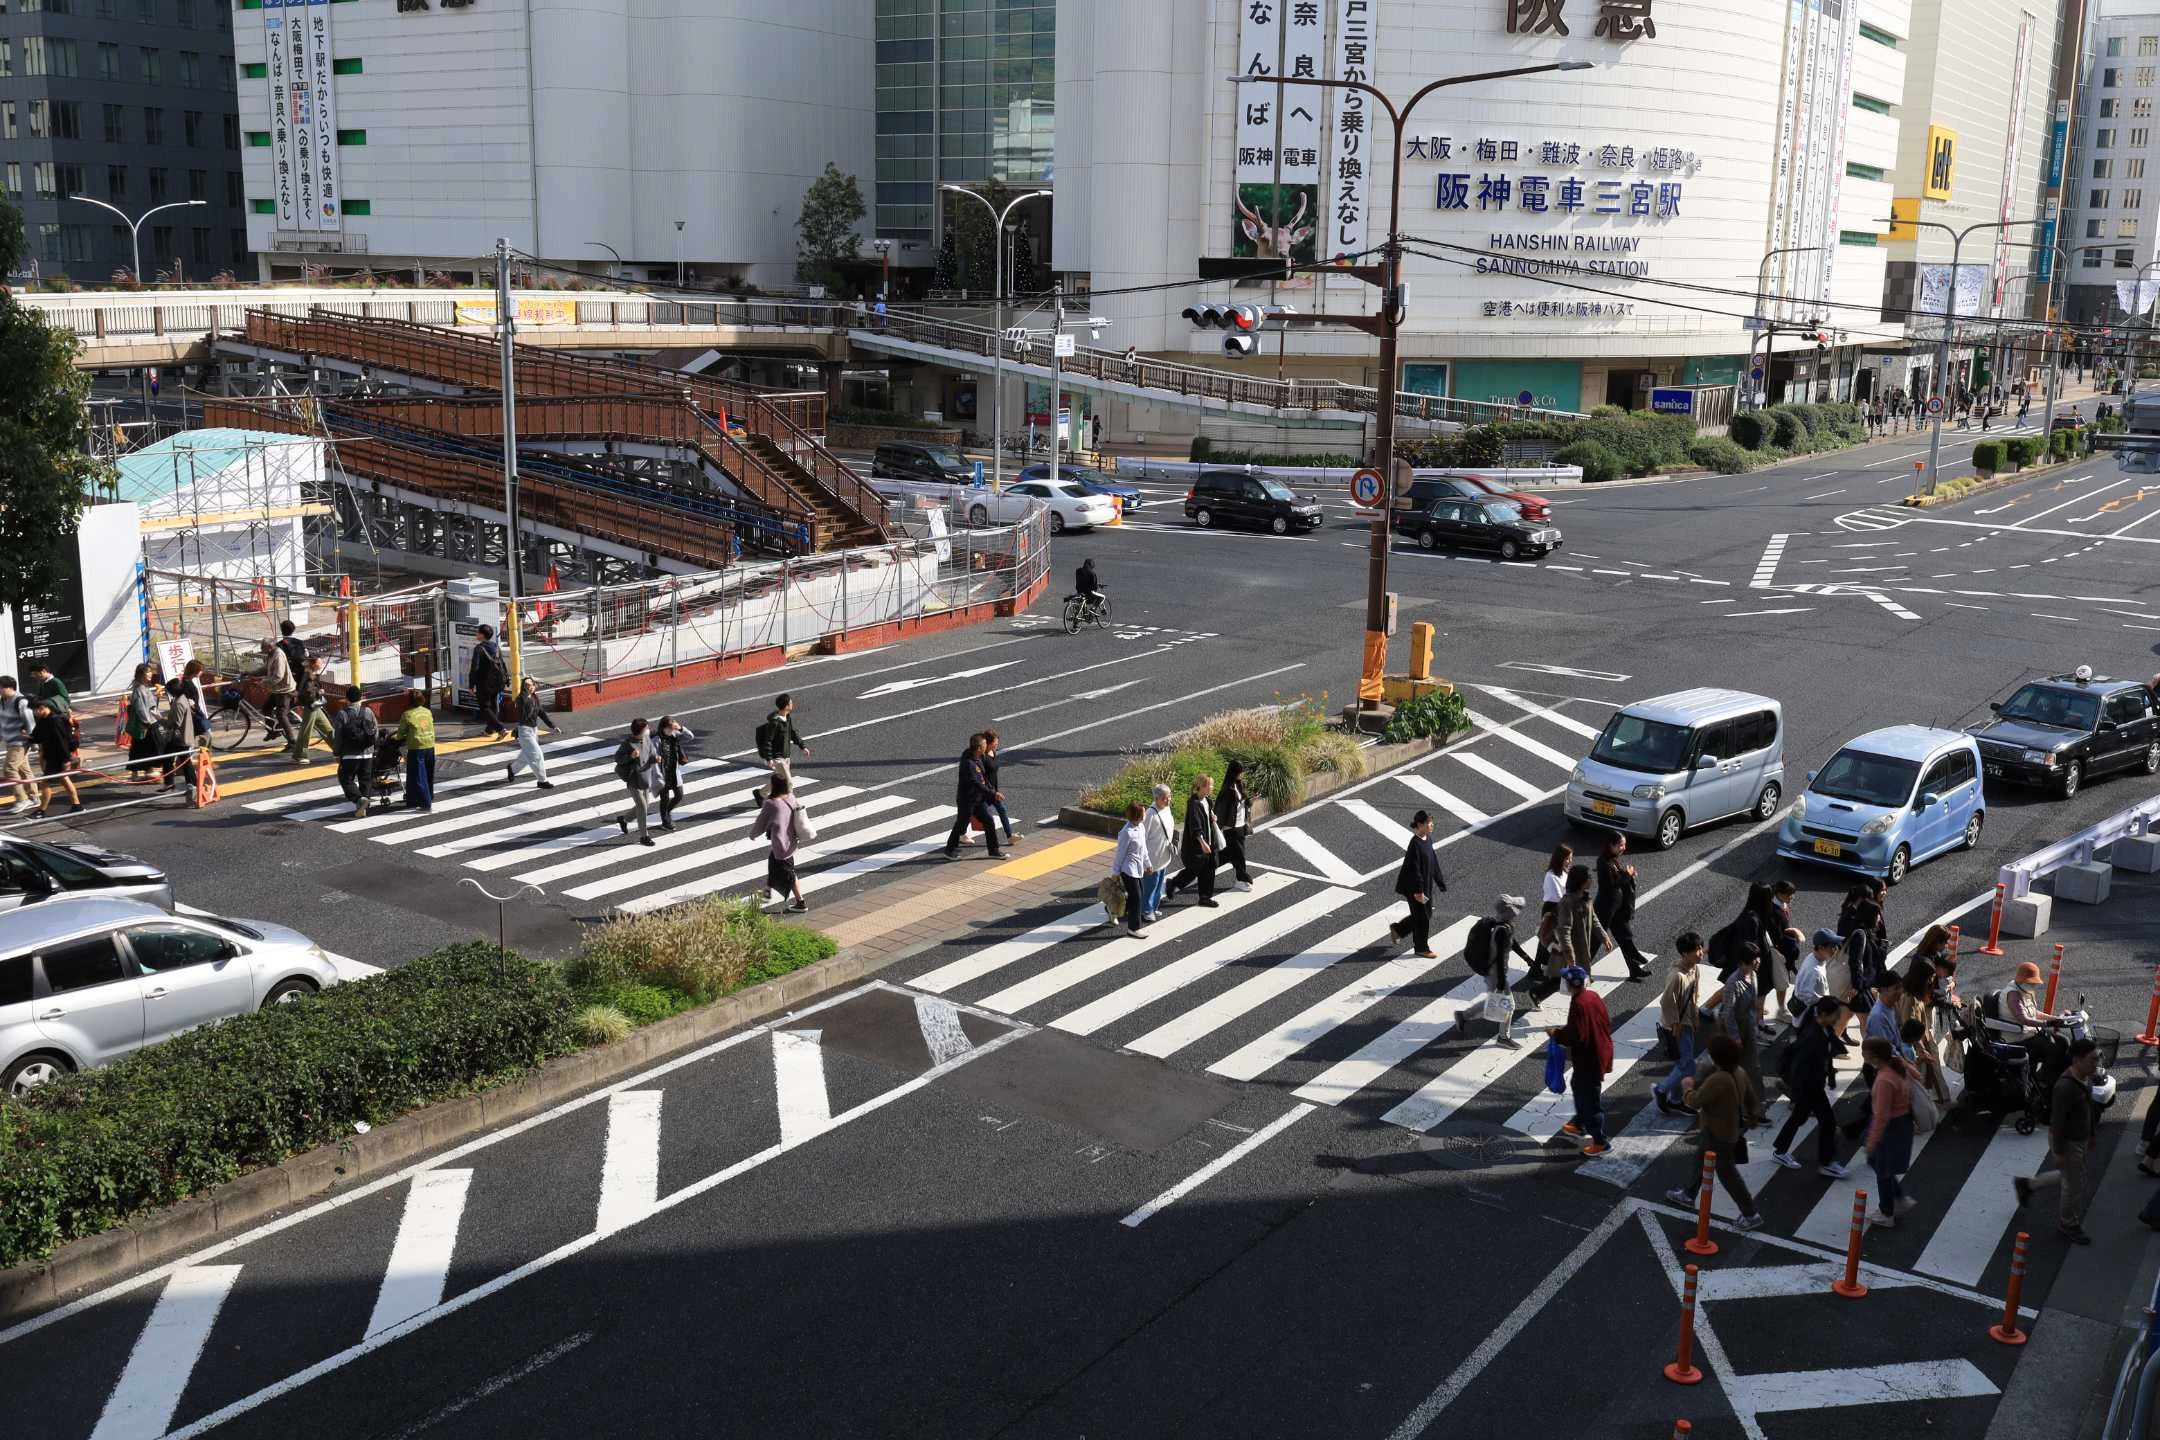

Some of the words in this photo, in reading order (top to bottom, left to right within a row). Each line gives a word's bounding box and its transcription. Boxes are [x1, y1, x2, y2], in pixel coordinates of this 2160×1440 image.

[1246, 1, 1272, 126] なんば
[1290, 2, 1318, 123] 奈良へ
[313, 16, 333, 198] 地下駅だからいつも快適
[1931, 136, 1952, 191] Loft
[1436, 173, 1682, 217] 阪神電車三宮駅
[1476, 257, 1580, 276] SANNOMIYA
[1588, 260, 1649, 277] STATION
[1490, 233, 1569, 251] HANSHIN
[1574, 235, 1641, 252] RAILWAY
